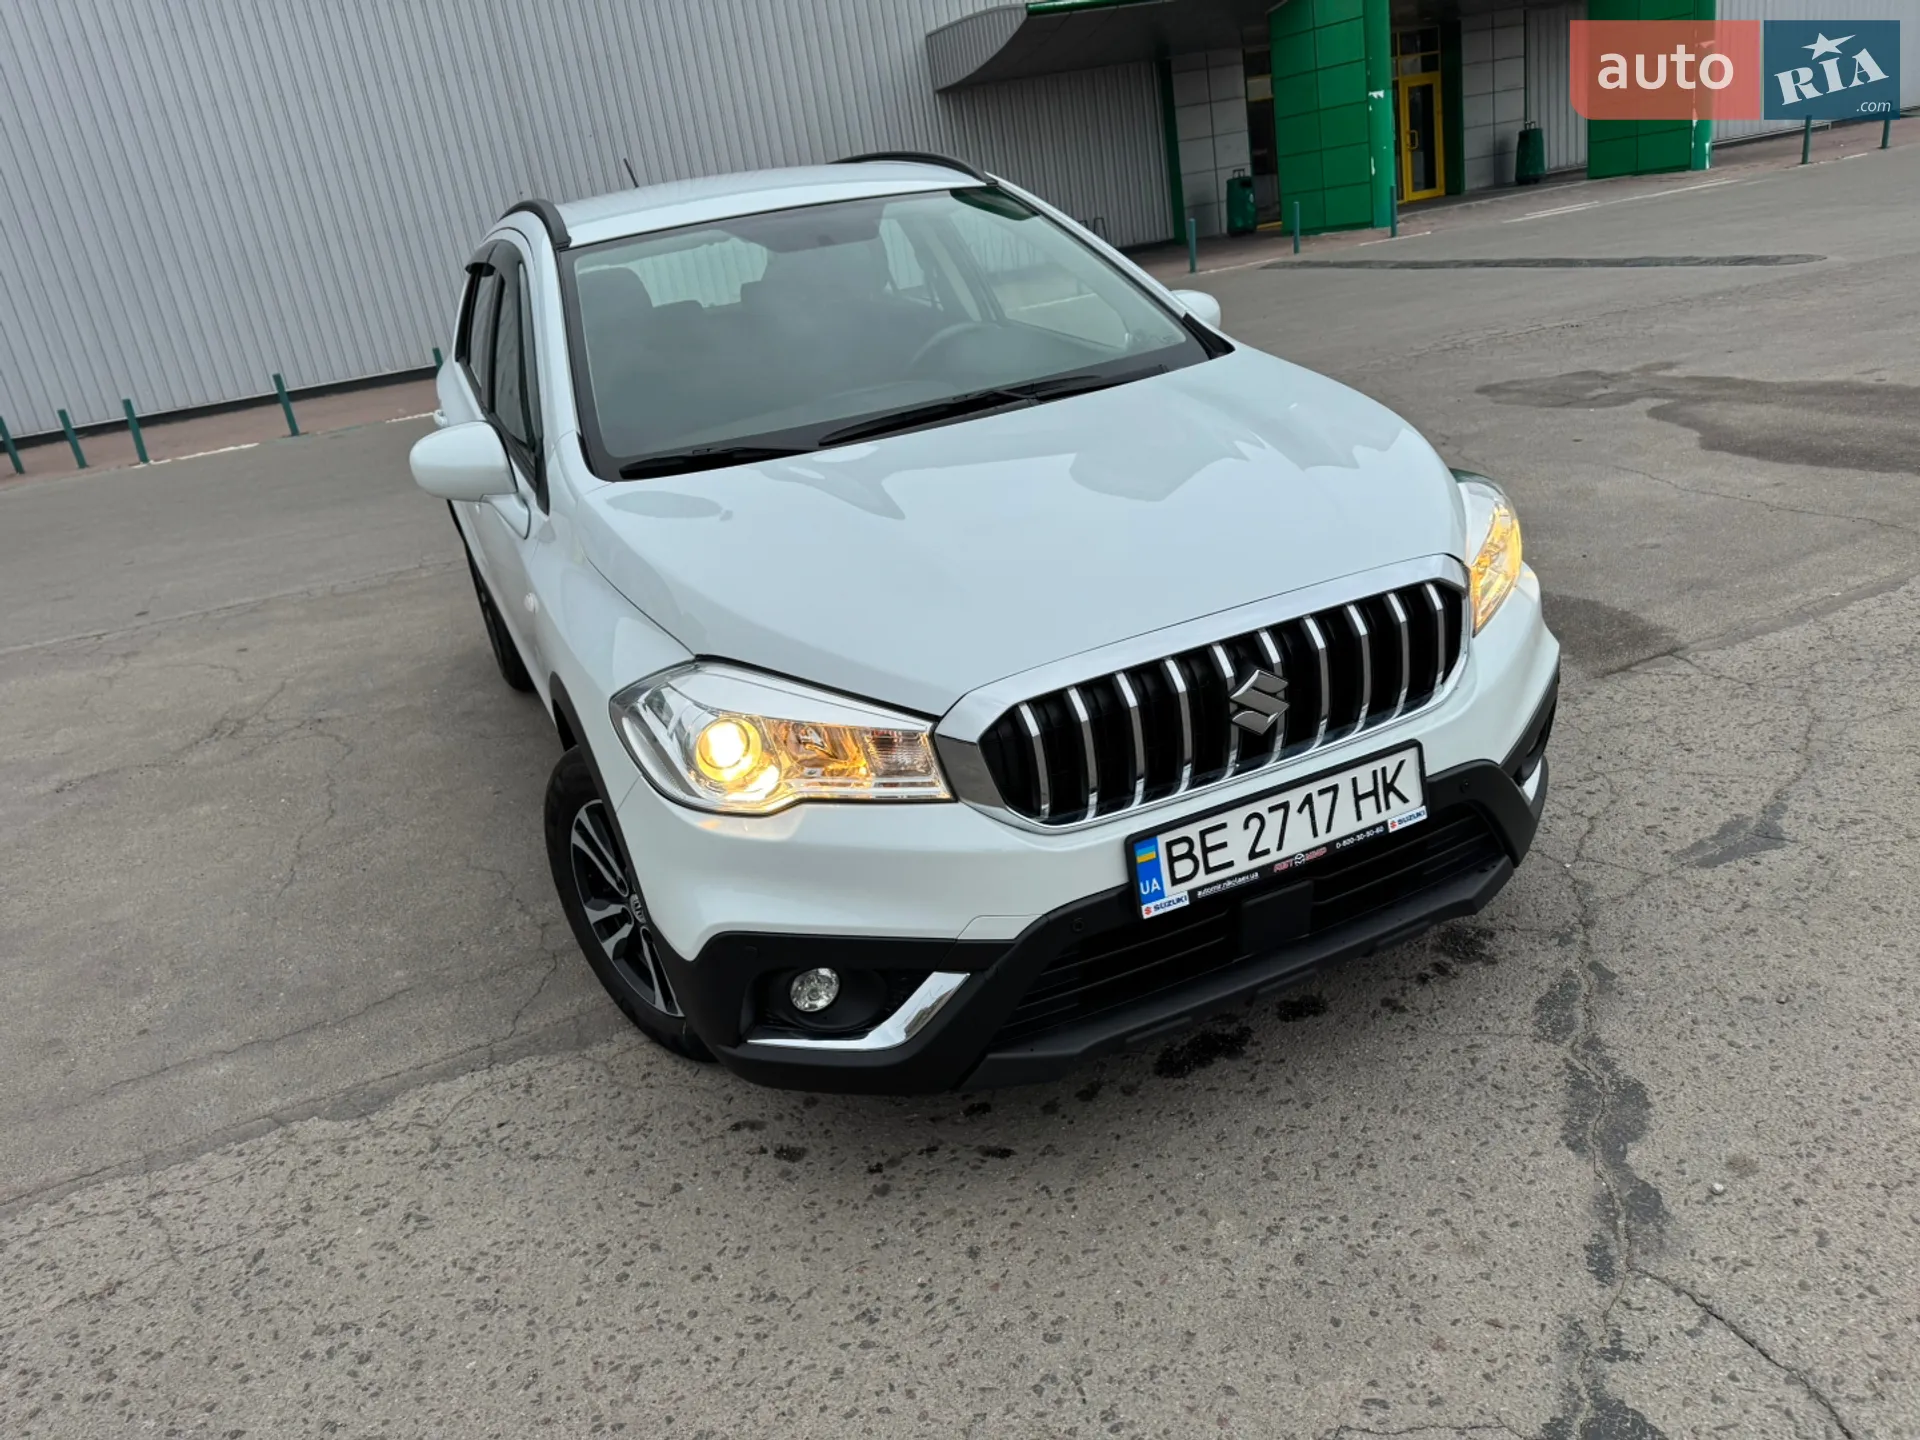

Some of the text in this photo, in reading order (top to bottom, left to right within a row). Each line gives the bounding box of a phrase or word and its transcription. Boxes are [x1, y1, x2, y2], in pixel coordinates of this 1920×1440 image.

[1165, 759, 1410, 887] BE 2717 HK
[1397, 809, 1426, 825] SUZUKI
[1140, 878, 1161, 895] UA
[1153, 895, 1188, 912] SUZUKI
